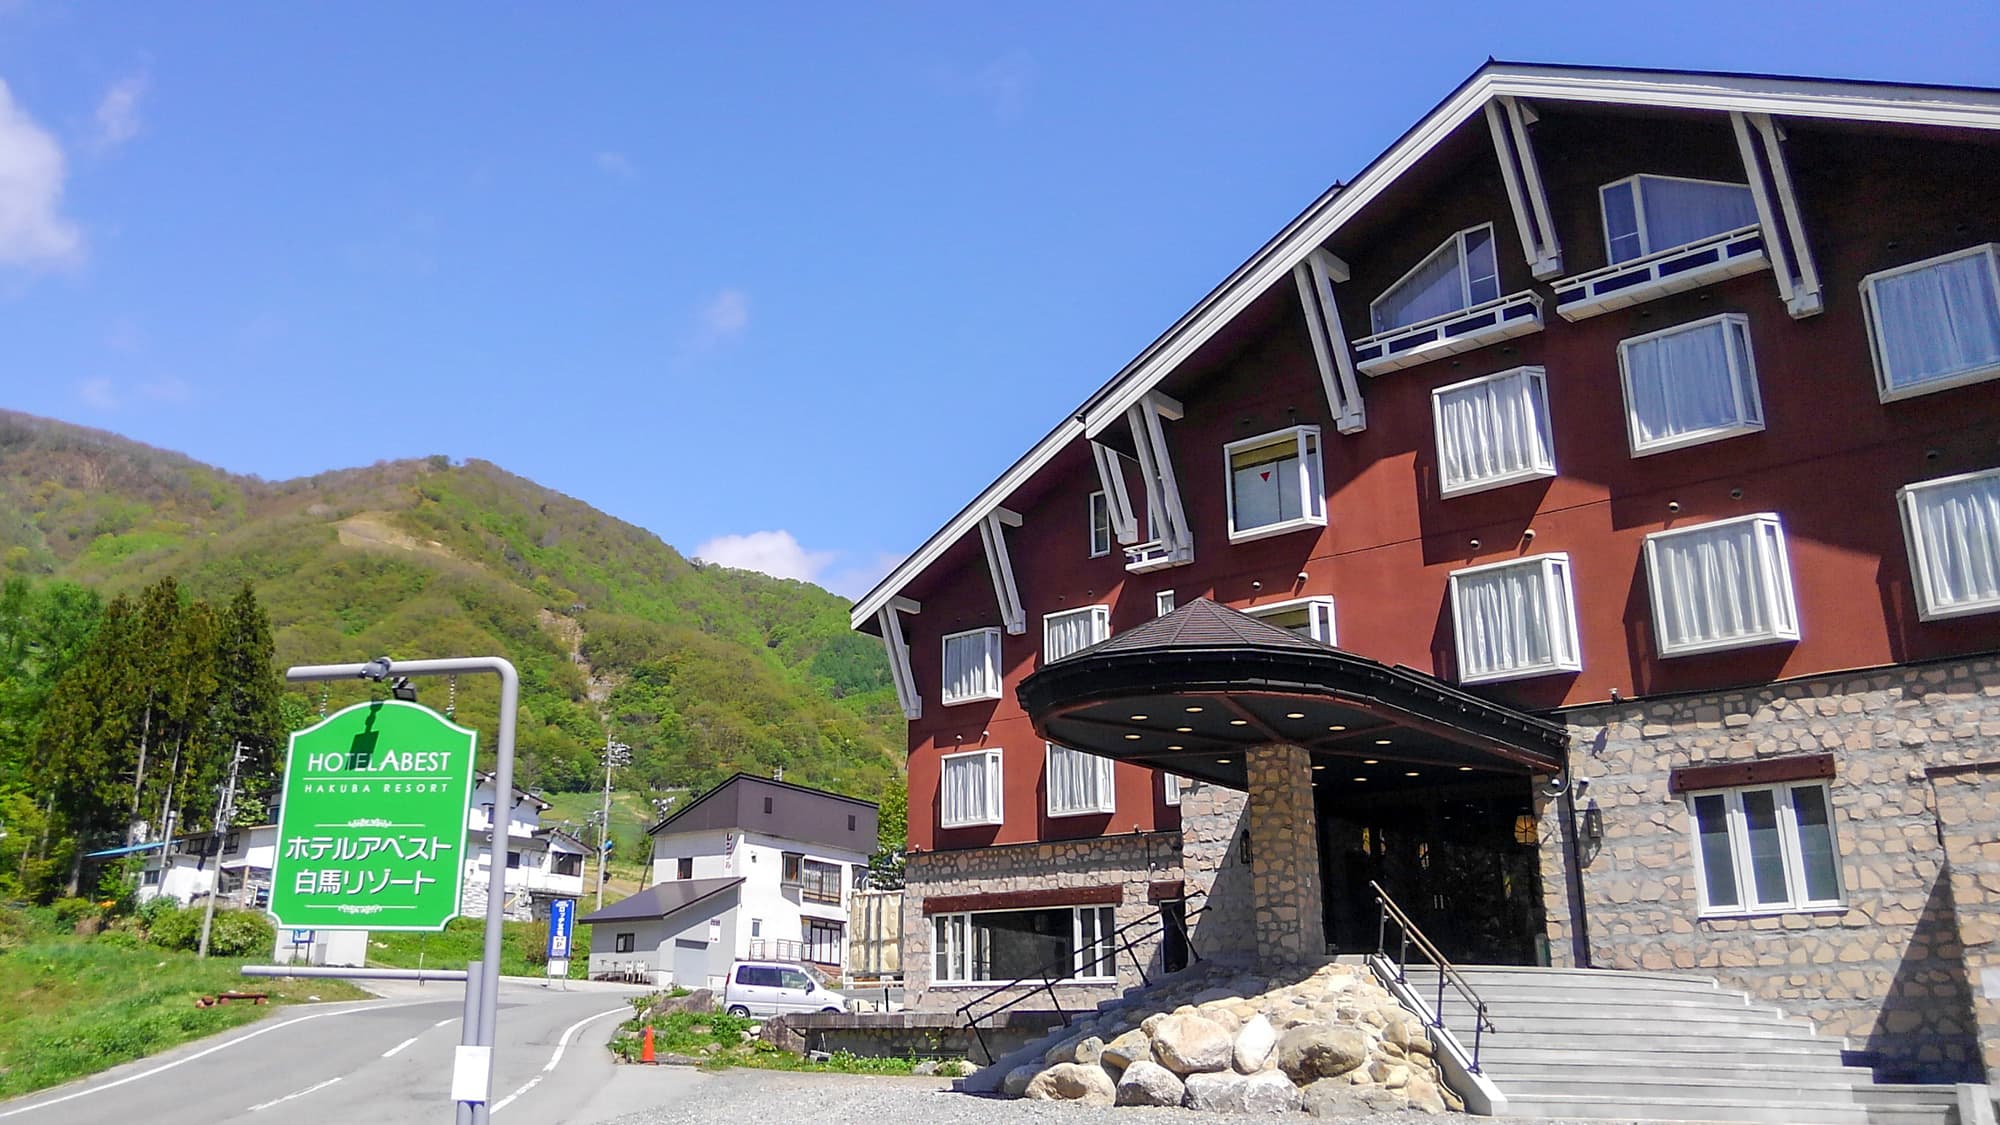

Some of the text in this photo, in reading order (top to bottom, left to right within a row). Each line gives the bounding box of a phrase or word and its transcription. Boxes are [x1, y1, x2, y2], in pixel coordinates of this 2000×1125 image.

[308, 749, 452, 772] HOTEL ABEST
[304, 783, 448, 793] HAKUBA RESORT
[285, 835, 452, 861] ホテルアベスト
[295, 868, 437, 895] 白馬リゾート
